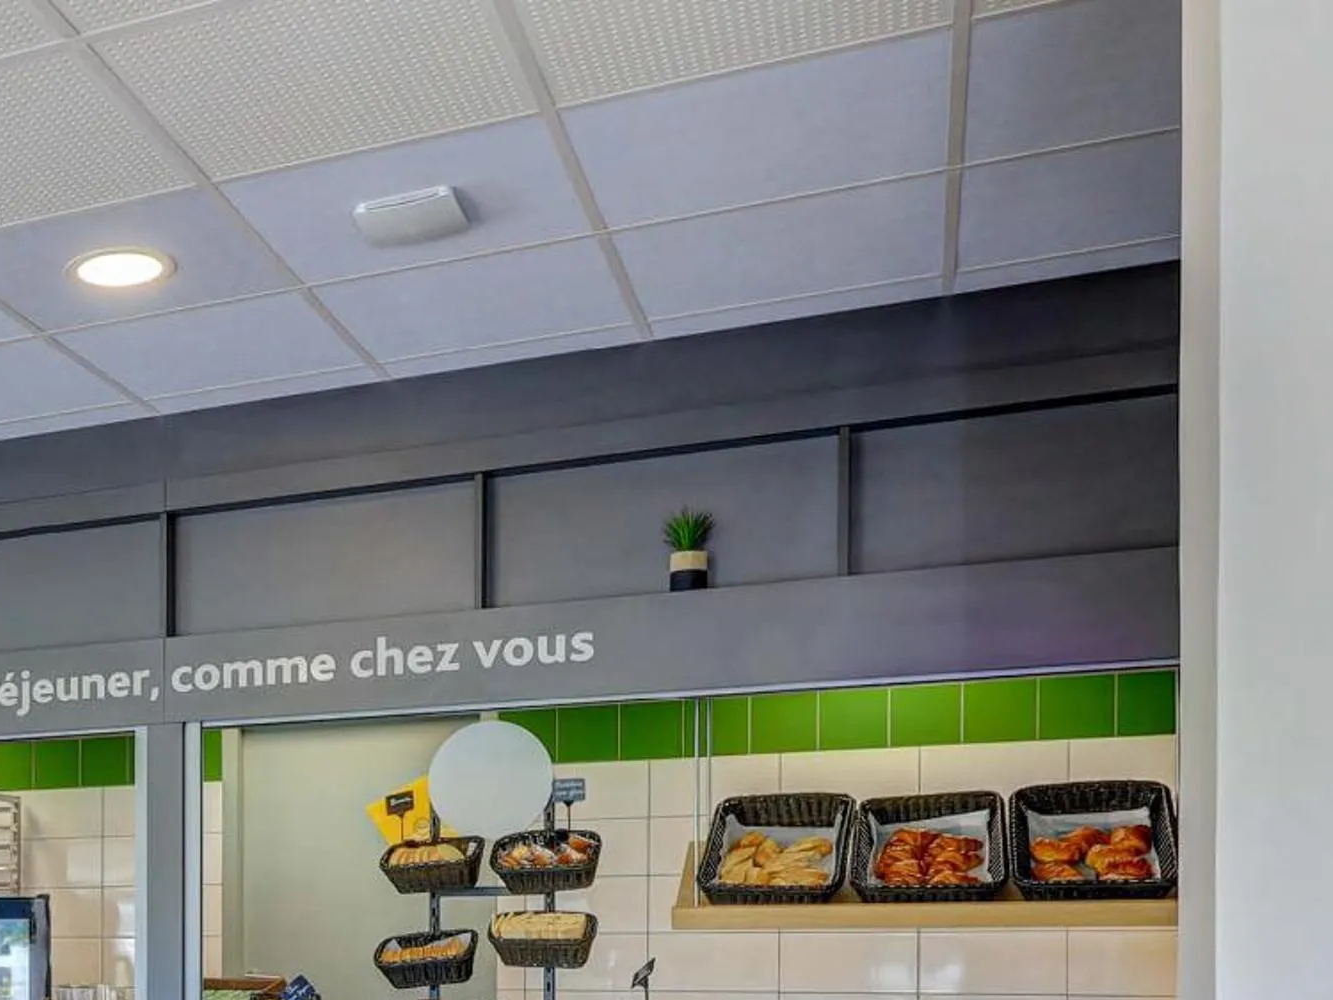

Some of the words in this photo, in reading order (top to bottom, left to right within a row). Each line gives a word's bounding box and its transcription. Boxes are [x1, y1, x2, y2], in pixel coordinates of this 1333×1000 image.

[170, 652, 337, 693] comme
[349, 636, 461, 679] chez
[472, 631, 596, 669] vous
